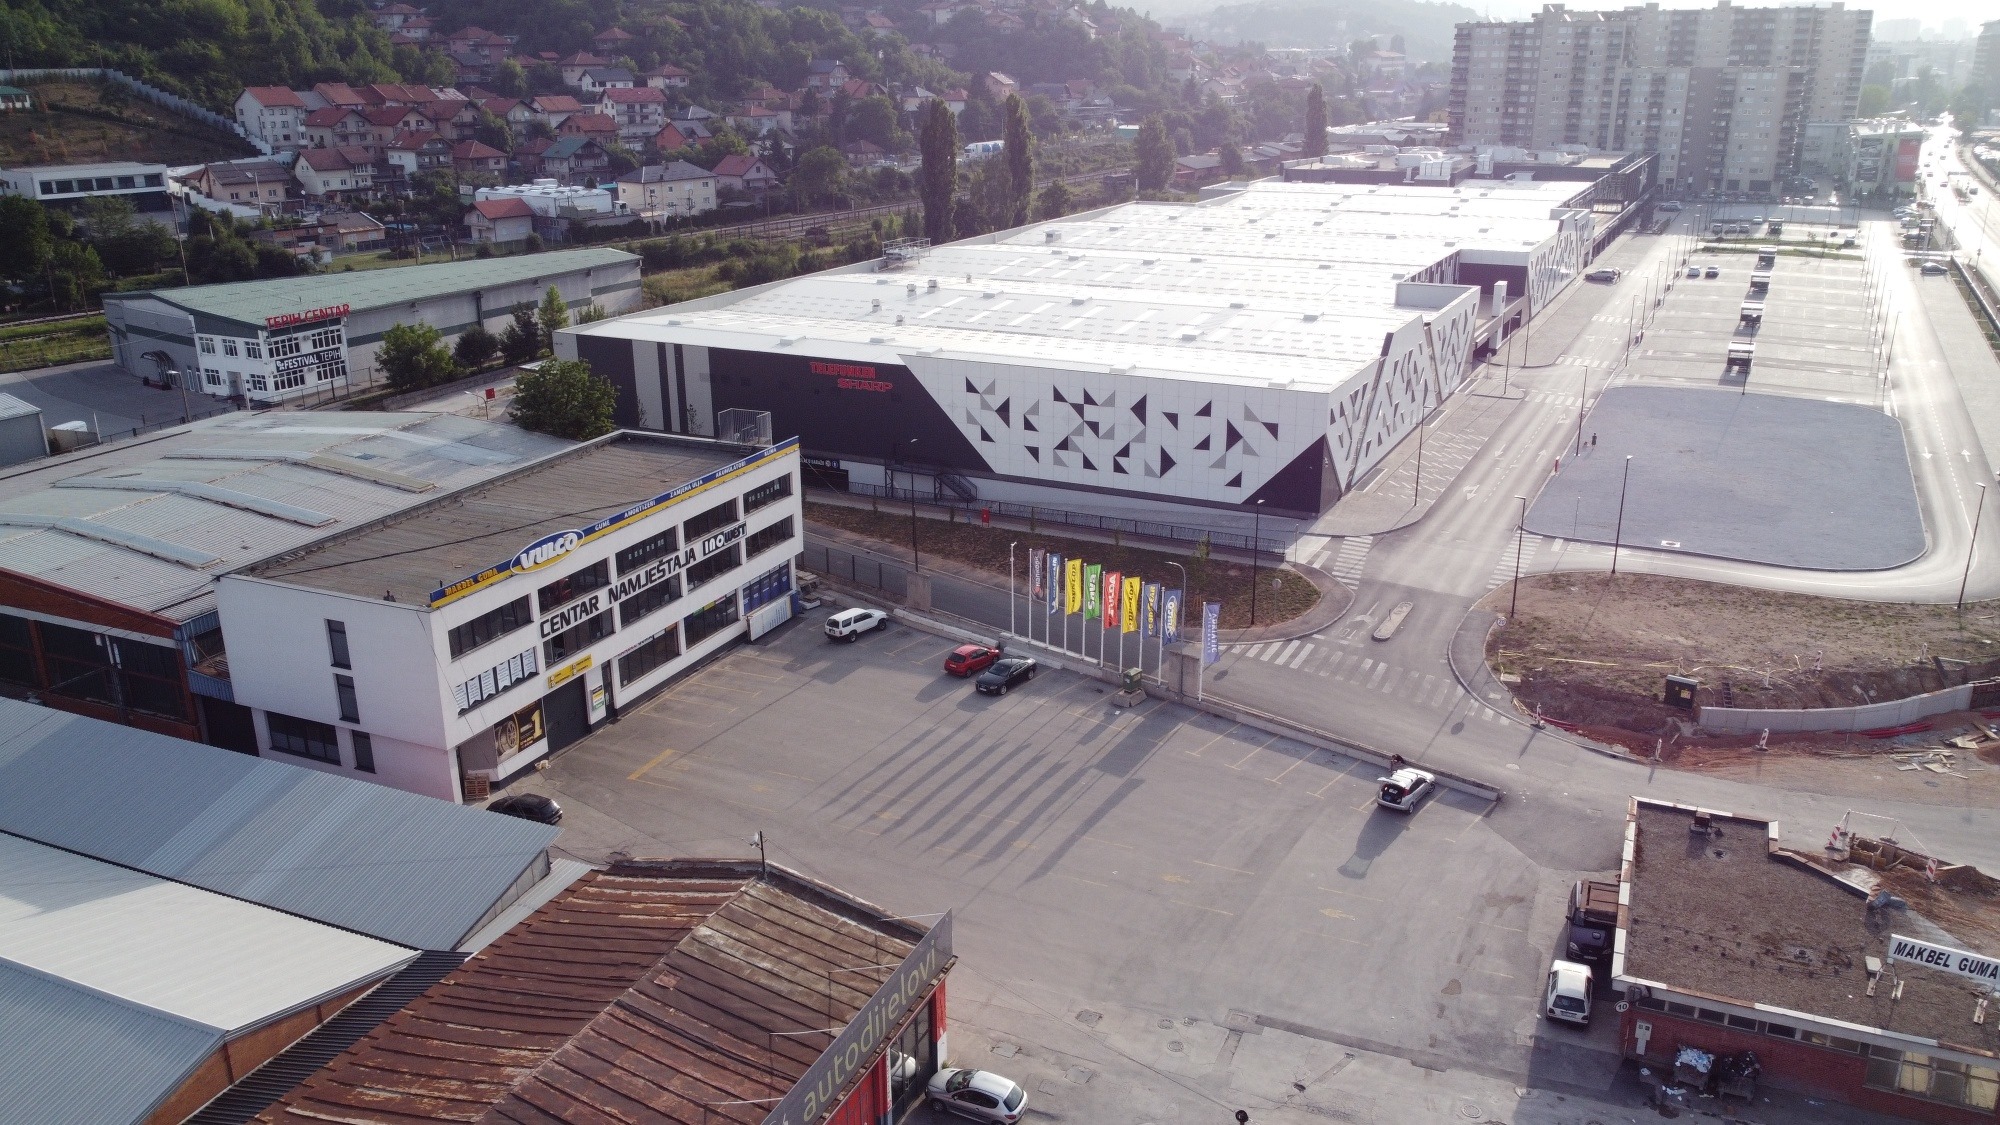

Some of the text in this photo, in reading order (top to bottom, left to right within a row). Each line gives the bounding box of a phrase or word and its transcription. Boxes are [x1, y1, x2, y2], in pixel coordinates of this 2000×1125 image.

[266, 304, 350, 329] TEPIH CENTAR
[810, 362, 876, 379] TELEFUNKEN
[838, 377, 893, 392] SHARP
[594, 520, 610, 531] GUME
[624, 500, 656, 518] AMORTIZERI
[670, 484, 691, 498] ZAMJENA
[520, 532, 578, 570] VULCO
[444, 568, 500, 597] MAKBEL GUMA
[540, 595, 600, 639] CENTAR
[608, 547, 697, 604] NAMJEŠTAJA
[1893, 941, 1999, 980] MAKBEL GUMA
[803, 939, 936, 1122] autodijelovi
